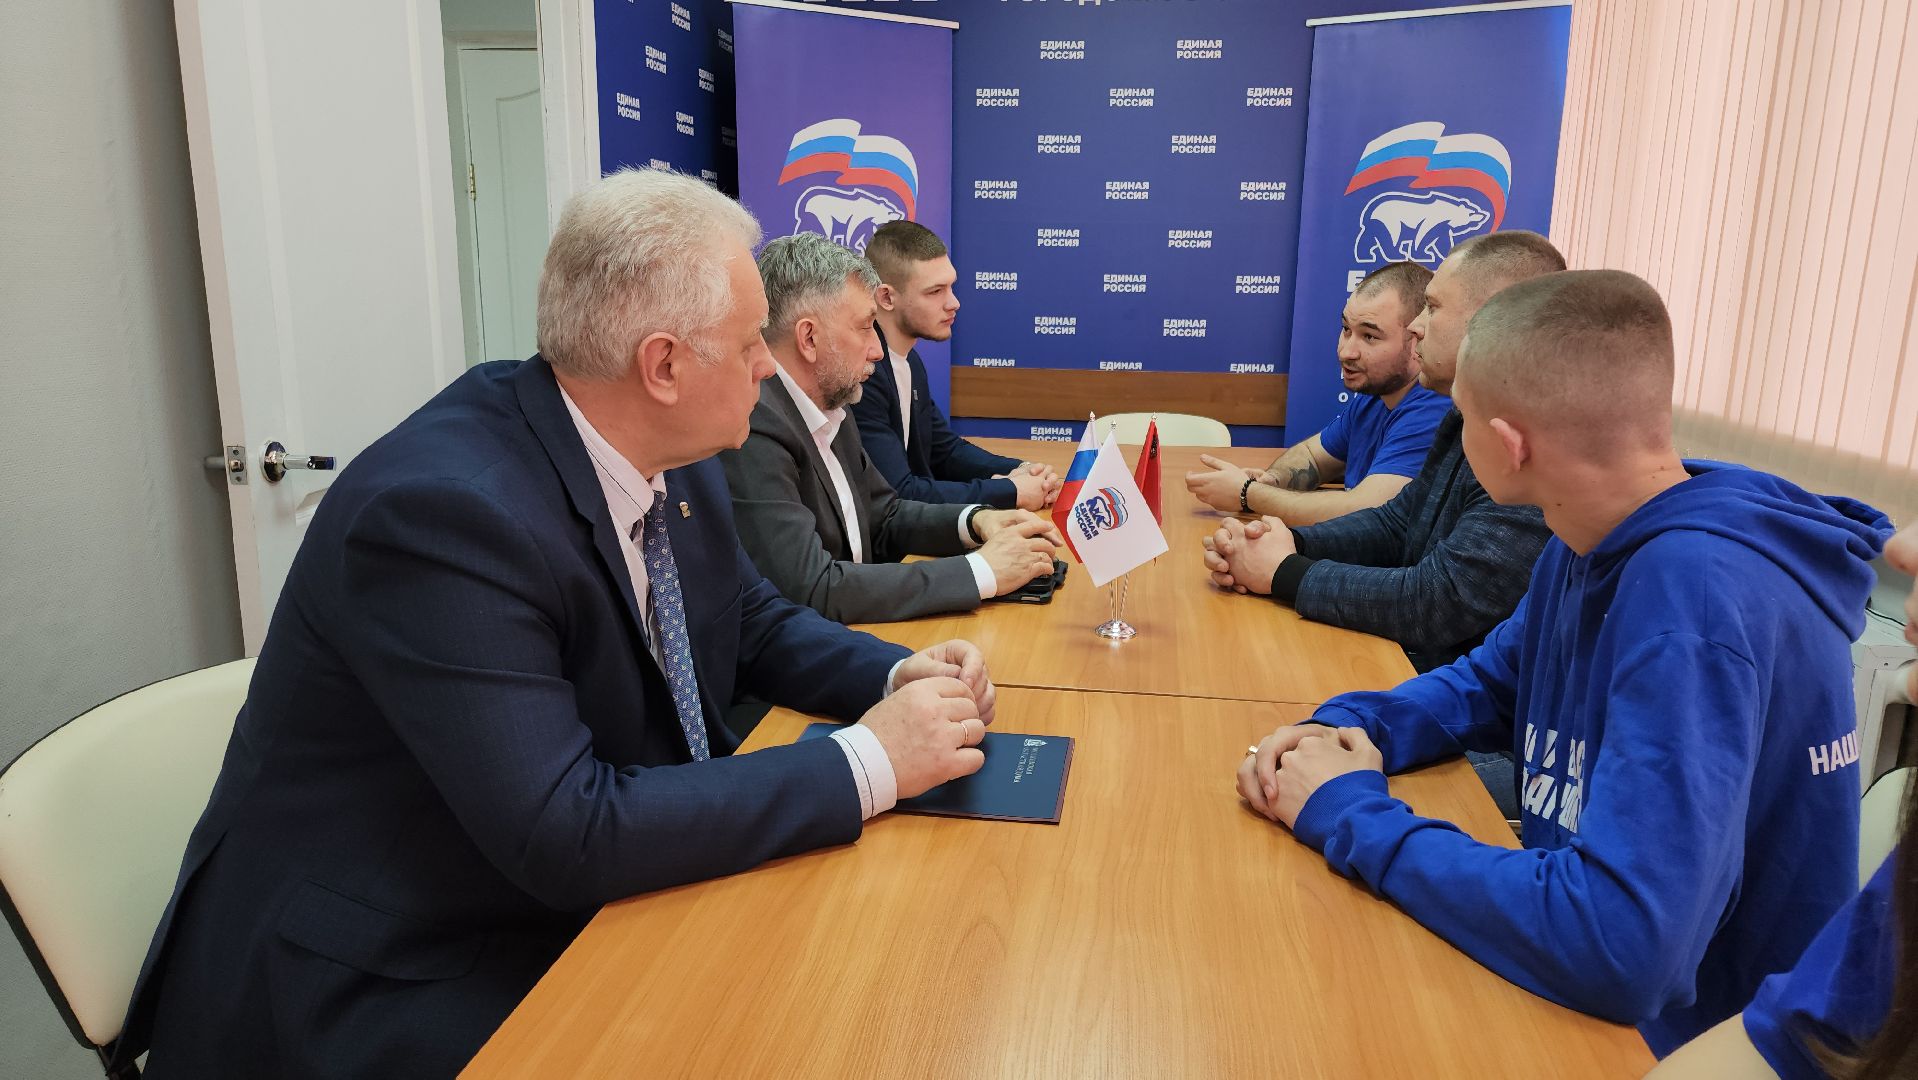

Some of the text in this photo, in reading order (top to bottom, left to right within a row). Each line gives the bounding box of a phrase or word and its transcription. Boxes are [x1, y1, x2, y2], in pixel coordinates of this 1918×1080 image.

[671, 14, 690, 31] РОССИЯ
[1041, 41, 1084, 50] ЕДИНАЯ
[1177, 40, 1222, 49] ЕДИНАЯ
[645, 46, 667, 62] ЕДИНАЯ
[1041, 51, 1084, 59] РОССИЯ
[1177, 49, 1221, 58] РОССИЯ
[646, 58, 667, 74] РОССИЯ
[976, 89, 1019, 98] ЕДИНАЯ
[1110, 89, 1154, 98] ЕДИНАЯ
[1247, 88, 1292, 97] ЕДИНАЯ
[617, 93, 640, 108] ЕДИНАЯ
[1247, 98, 1291, 106] РОССИЯ
[618, 105, 640, 121] РОССИЯ
[676, 123, 694, 136] РОССИЯ
[1038, 135, 1081, 144] ЕДИНАЯ
[1172, 135, 1216, 144] ЕДИНАЯ
[1038, 145, 1080, 153] РОССИЯ
[1172, 145, 1215, 153] РОССИЯ
[975, 181, 1017, 190] ЕДИНАЯ
[1106, 182, 1149, 191] ЕДИНАЯ
[1241, 182, 1286, 191] ЕДИНАЯ
[975, 191, 1016, 199] РОССИЯ
[1240, 192, 1285, 200] РОССИЯ
[1038, 229, 1079, 238] ЕДИНАЯ
[1169, 231, 1212, 239] ЕДИНАЯ
[1168, 239, 1211, 248] РОССИЯ
[976, 272, 1017, 281] ЕДИНАЯ
[1104, 275, 1146, 283] ЕДИНАЯ
[1236, 276, 1280, 285] ЕДИНАЯ
[976, 282, 1017, 290] РОССИЯ
[1104, 283, 1146, 292] РОССИЯ
[1236, 284, 1279, 293] РОССИЯ
[1035, 317, 1076, 326] ЕДИНАЯ
[1164, 319, 1206, 328] ЕДИНАЯ
[1163, 329, 1206, 337] РОССИЯ
[974, 359, 1014, 367] ЕДИНАЯ
[1100, 362, 1142, 370] ЕДИНАЯ
[1230, 364, 1274, 373] ЕДИНАЯ
[1031, 426, 1072, 435] ЕДИНАЯ
[1075, 506, 1092, 540] РОССИЯ
[1079, 503, 1099, 537] ЕДИНАЯ
